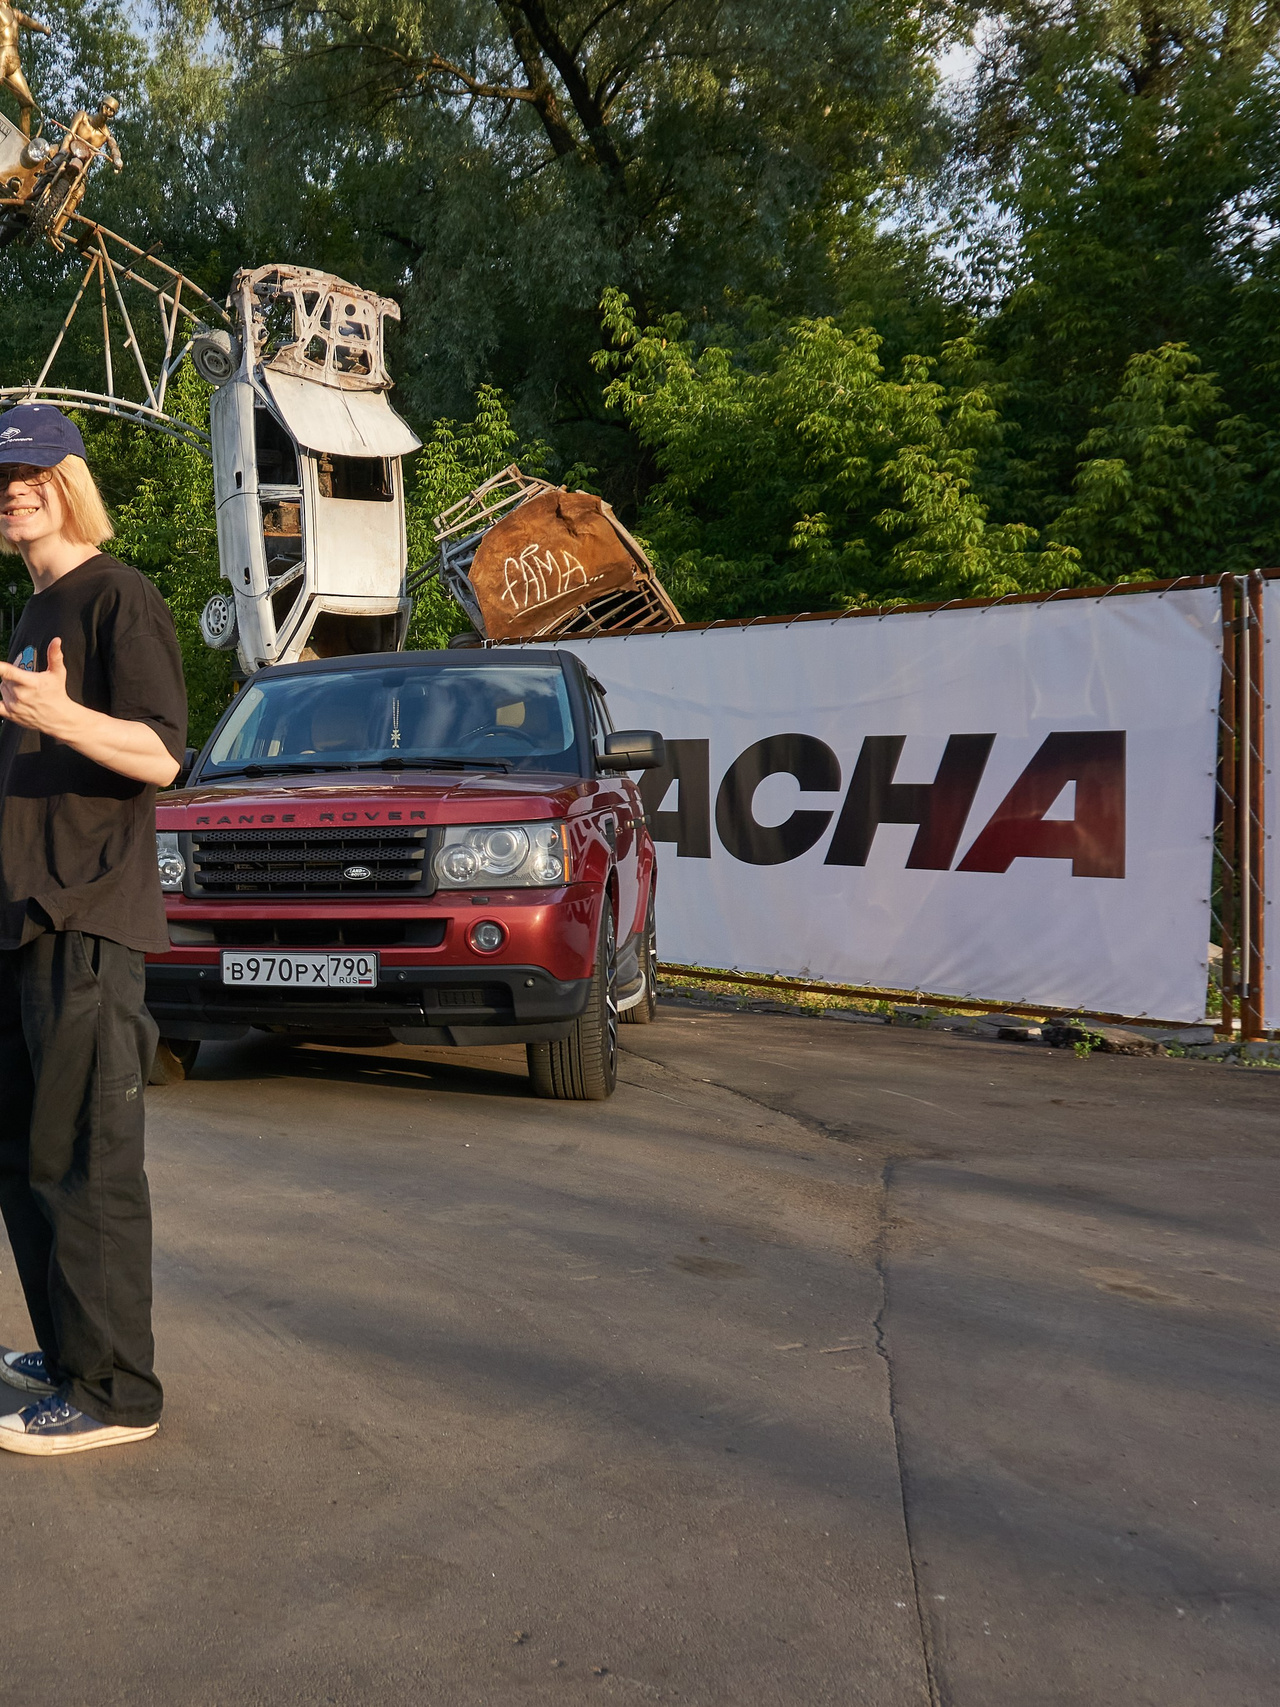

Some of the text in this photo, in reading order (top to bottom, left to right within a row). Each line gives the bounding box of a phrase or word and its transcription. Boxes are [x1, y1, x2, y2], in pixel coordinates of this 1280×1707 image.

[195, 810, 427, 825] RANGE ROVER
[330, 957, 369, 976] 790
[338, 976, 358, 984] RUS
